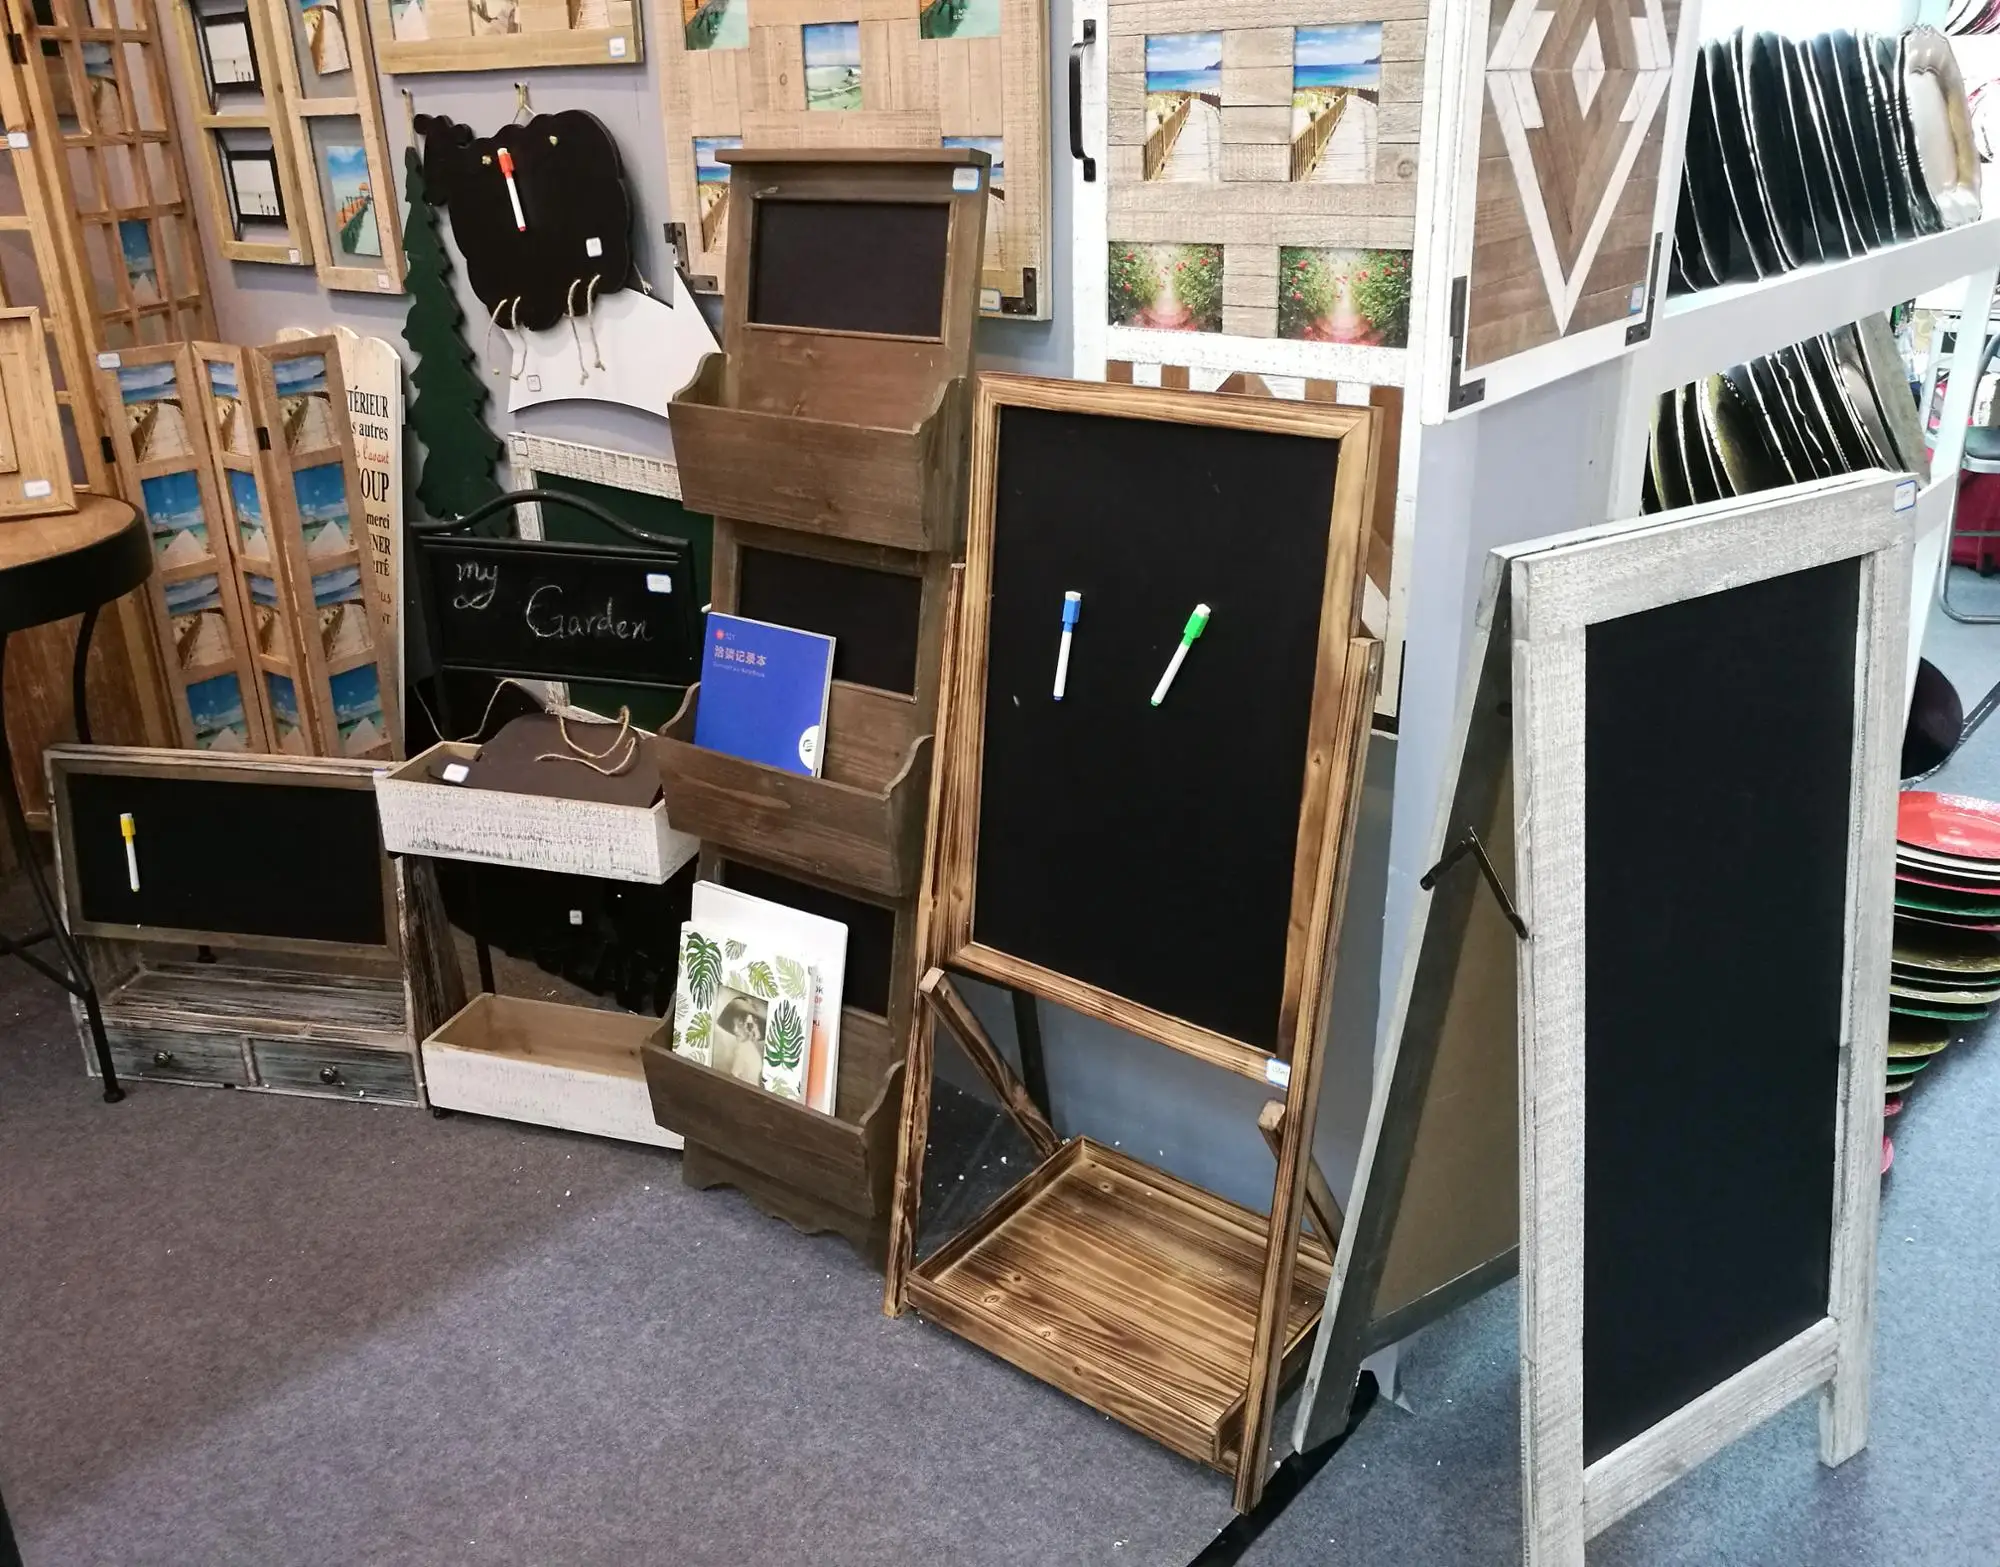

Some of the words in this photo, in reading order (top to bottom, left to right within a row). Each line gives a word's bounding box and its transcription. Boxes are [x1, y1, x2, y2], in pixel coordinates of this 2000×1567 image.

[359, 423, 389, 441] autres
[357, 467, 390, 503] OUP
[366, 513, 390, 530] merci
[369, 534, 391, 556] NER
[373, 559, 390, 577] ITÉ
[526, 585, 654, 640] Garden
